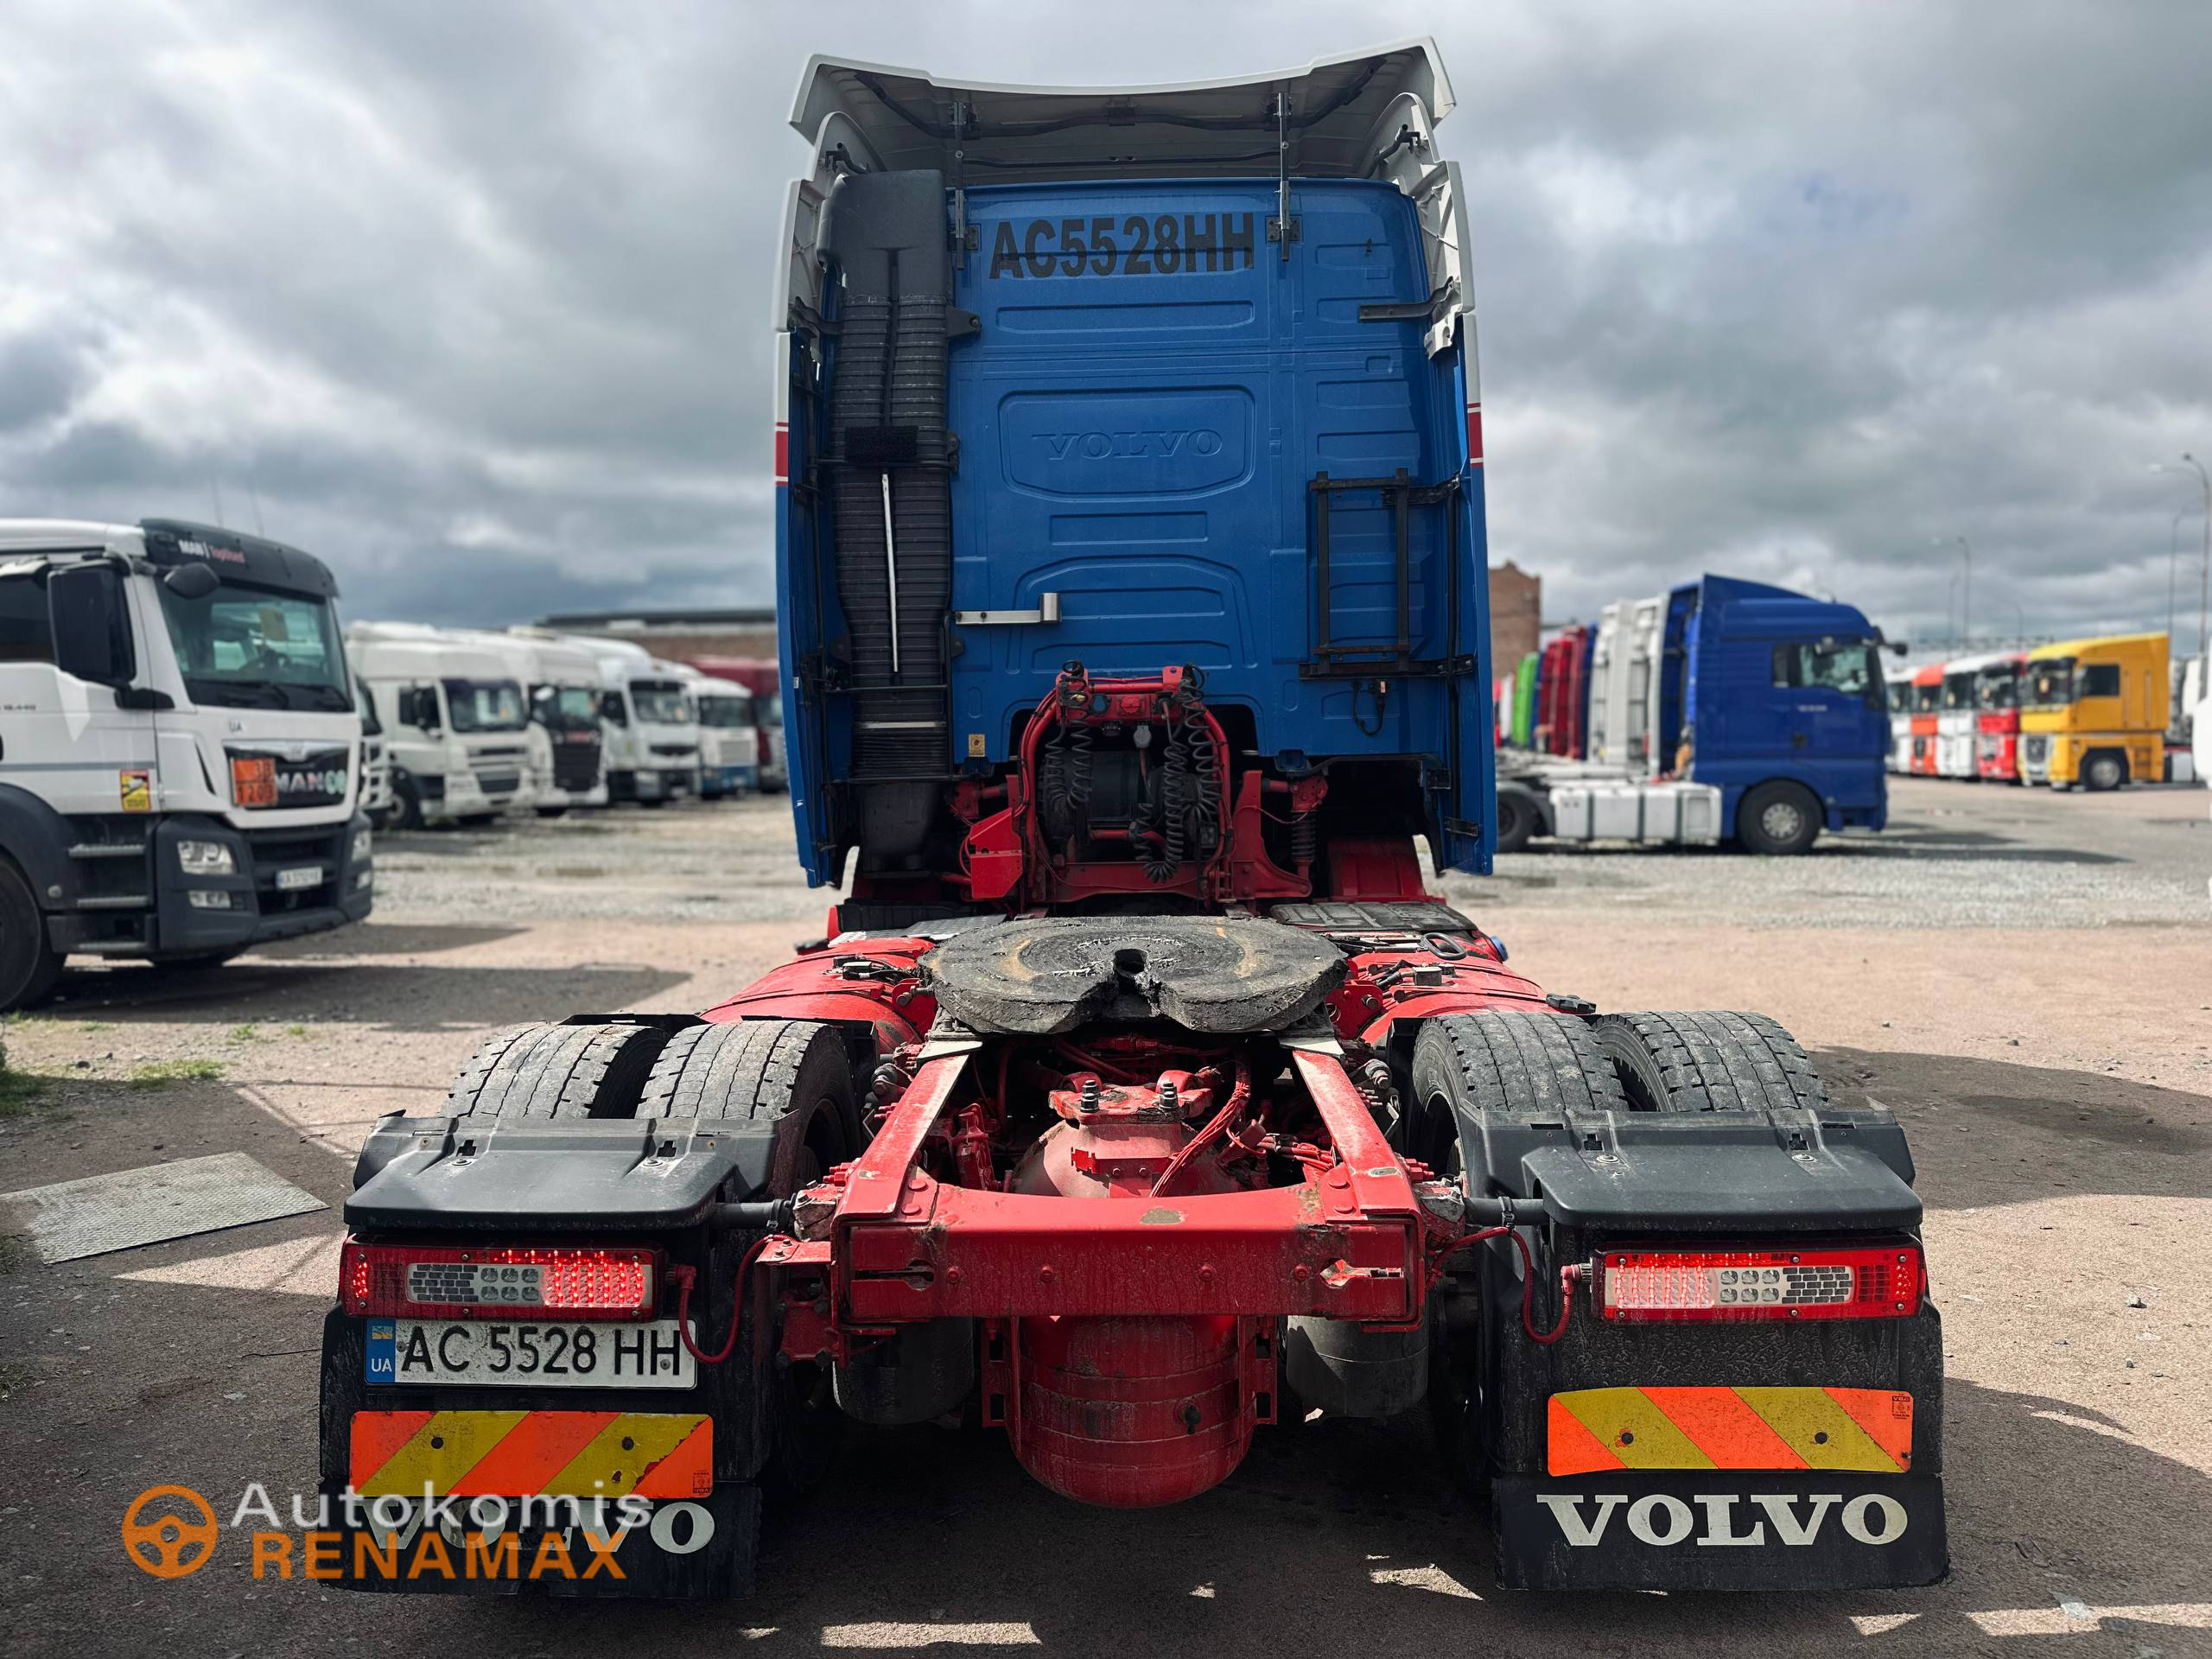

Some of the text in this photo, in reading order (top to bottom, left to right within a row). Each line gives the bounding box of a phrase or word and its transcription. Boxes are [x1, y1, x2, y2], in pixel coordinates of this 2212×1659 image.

[989, 213, 1255, 279] AC5528HH
[1031, 429, 1224, 461] VOLVO
[178, 539, 205, 556] MAN
[228, 721, 243, 733] UA
[274, 772, 325, 792] MAN
[401, 1325, 680, 1376] AC 5528 HH
[371, 1358, 392, 1373] UA
[1536, 1493, 1909, 1546] VOLVO
